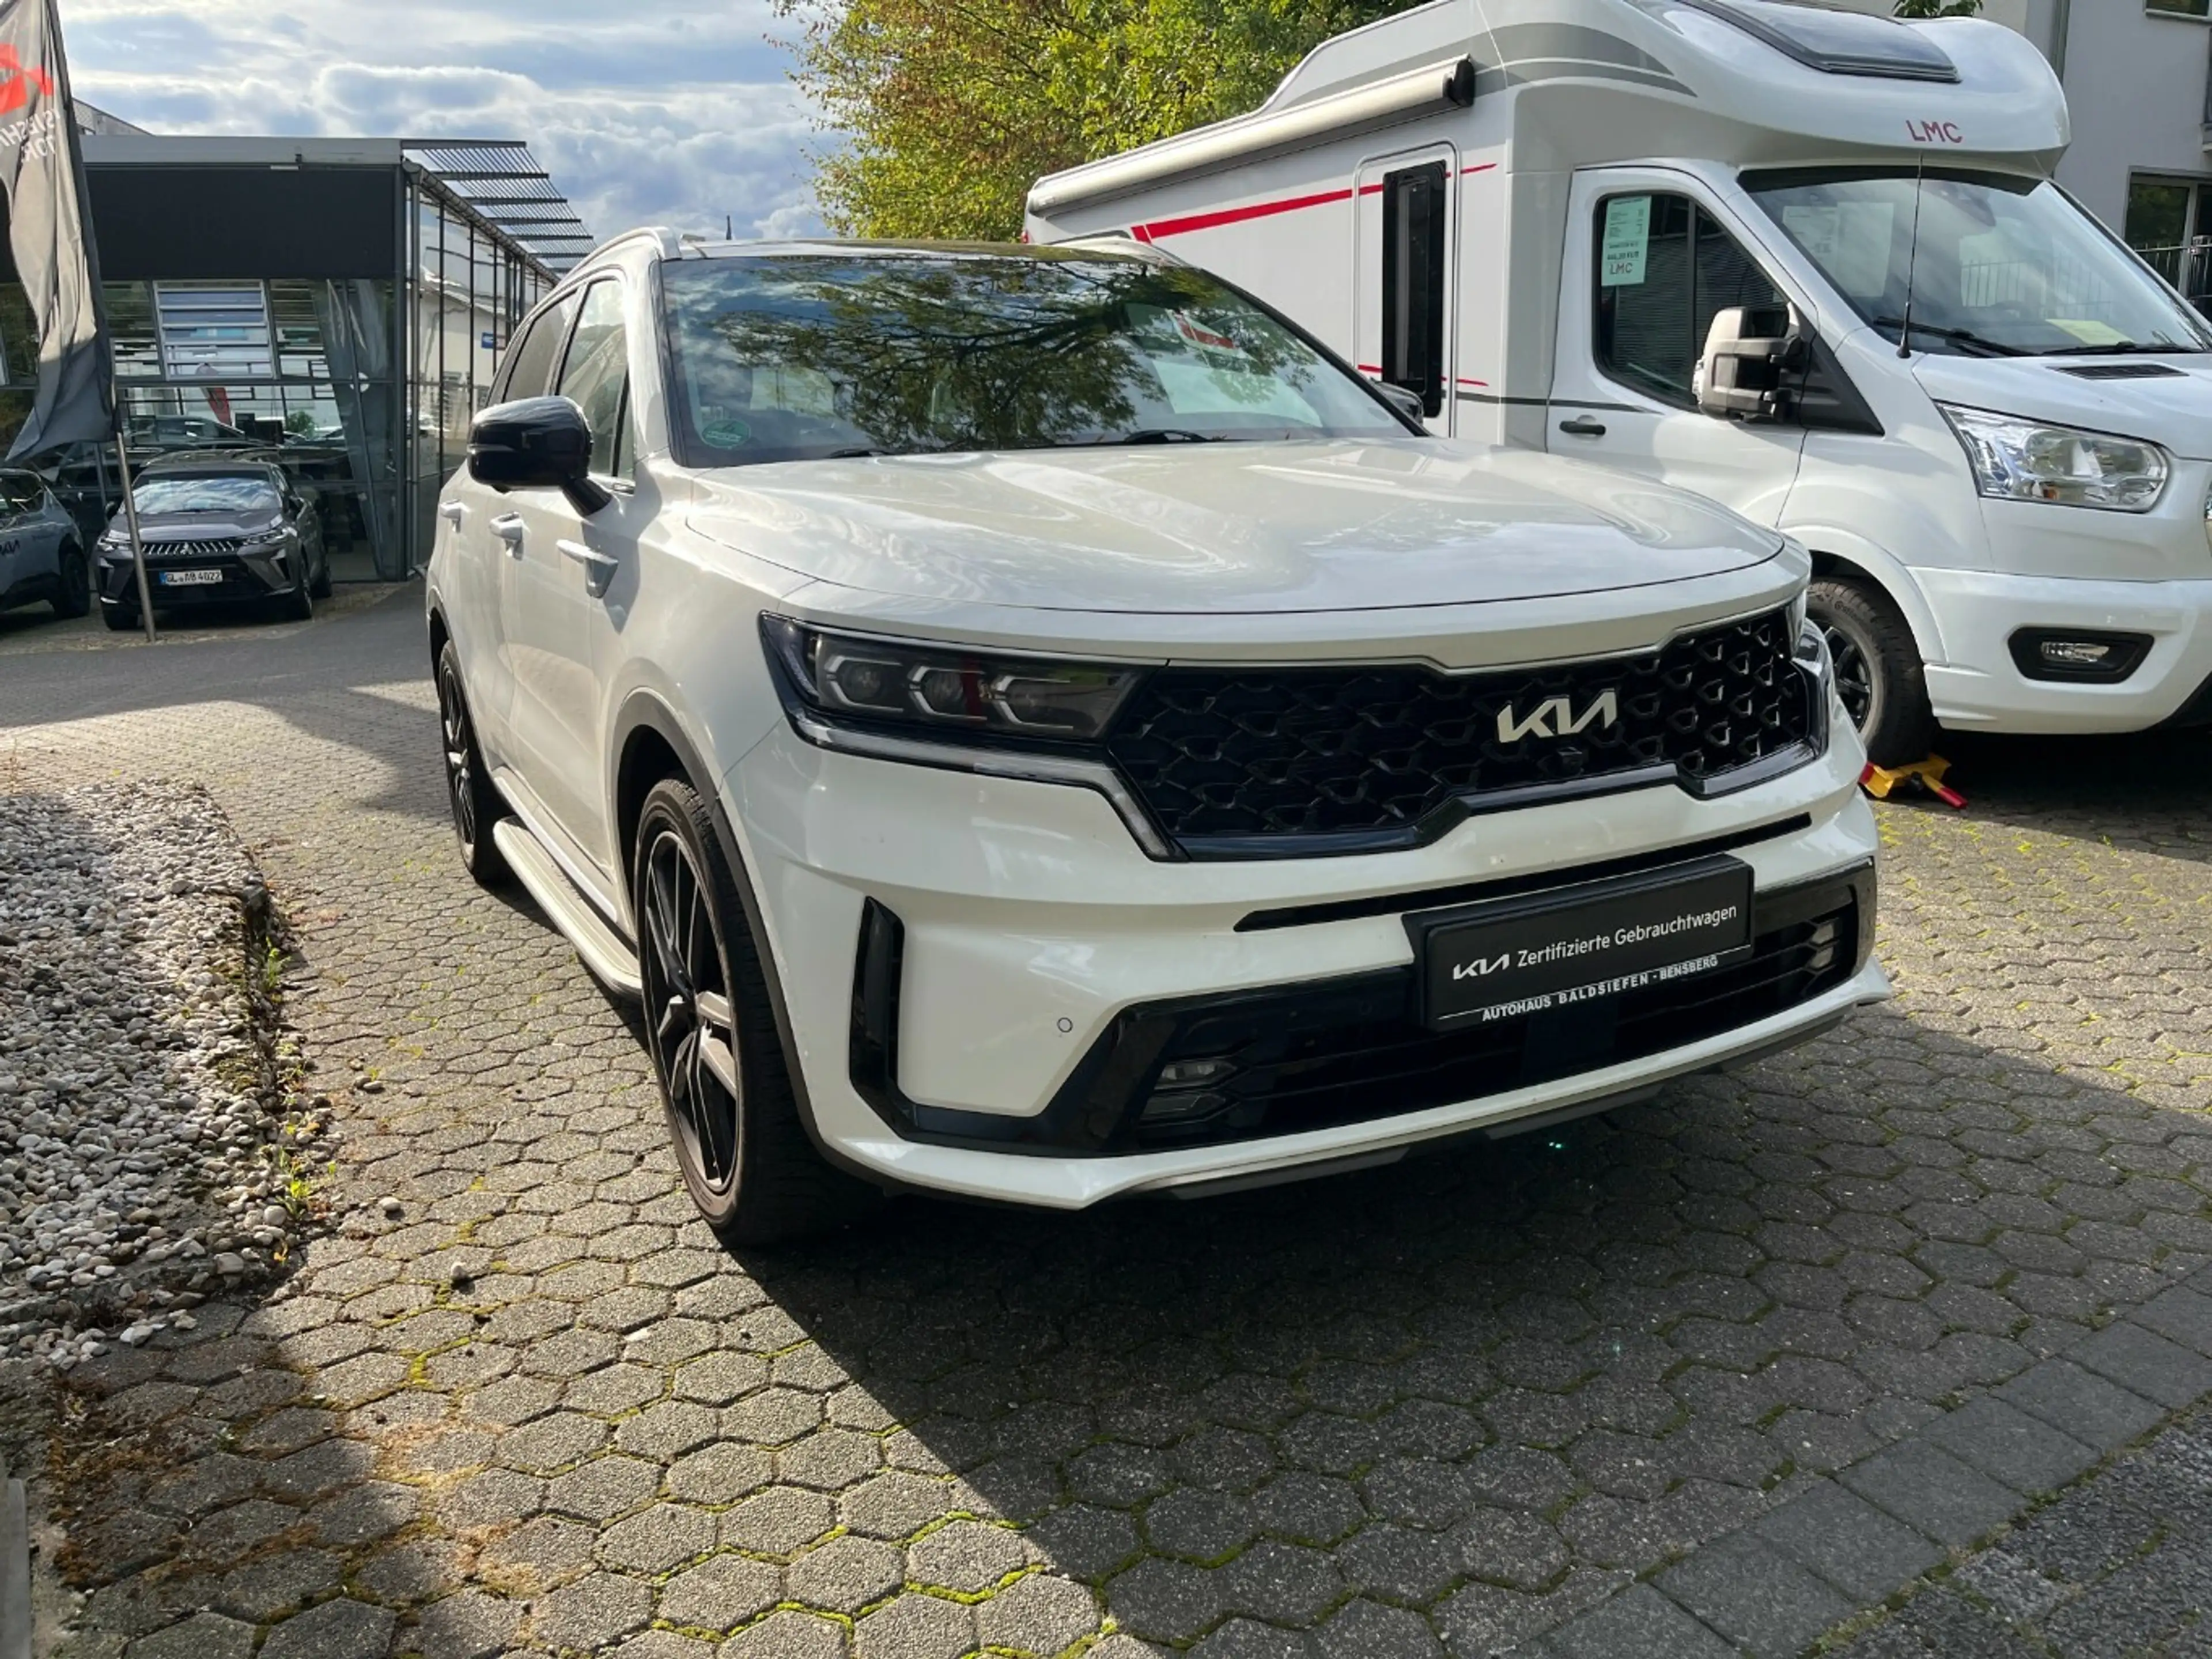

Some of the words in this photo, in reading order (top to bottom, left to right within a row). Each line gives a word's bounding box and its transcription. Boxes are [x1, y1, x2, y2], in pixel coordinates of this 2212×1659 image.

[1905, 120, 1963, 143] LMC
[1609, 262, 1632, 275] LMC
[1498, 688, 1617, 743] KIA
[1453, 954, 1510, 980] KIA
[1518, 934, 1610, 968] Zertifizierte
[1614, 905, 1737, 945] Gebrauchtwagen
[1482, 995, 1551, 1021] AUTOHAUS
[1559, 972, 1649, 1004] BALDSIEFEN
[1659, 954, 1718, 980] BENSBERG
